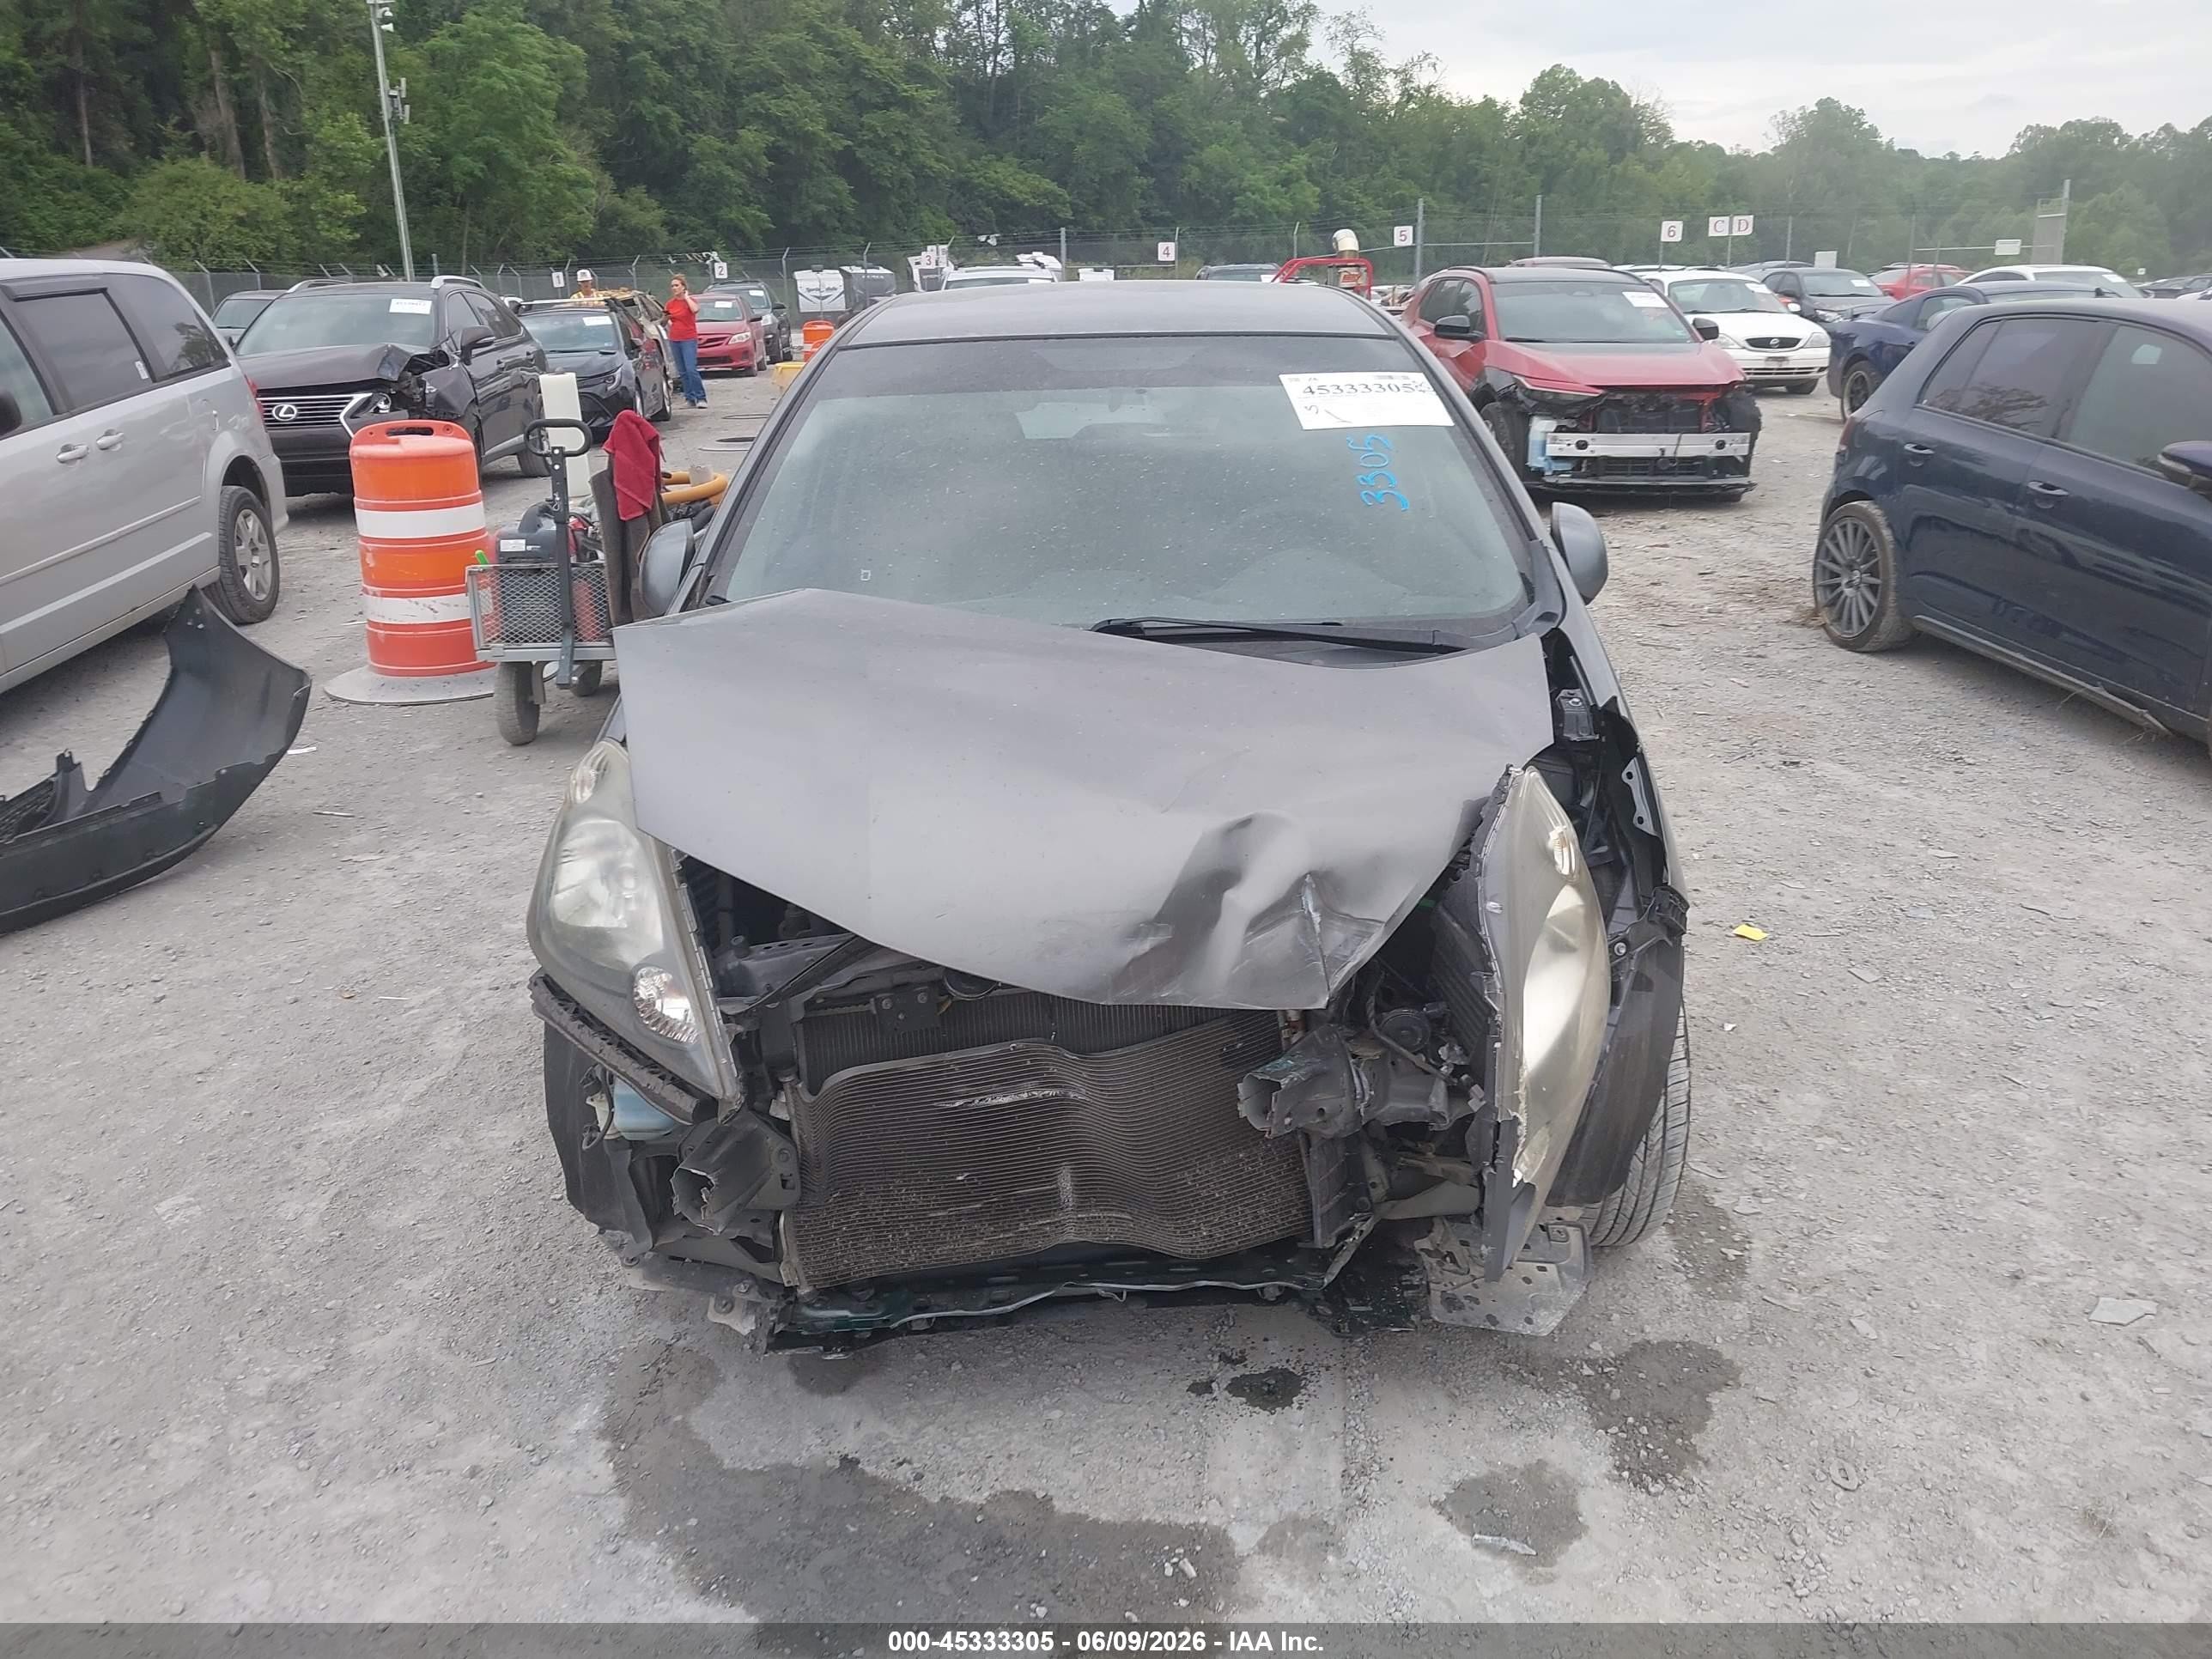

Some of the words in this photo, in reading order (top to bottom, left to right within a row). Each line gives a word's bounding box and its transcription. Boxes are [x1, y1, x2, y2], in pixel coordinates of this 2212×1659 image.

[1668, 225, 1676, 238] 6
[1713, 220, 1725, 234] C
[1737, 219, 1749, 233] D
[1399, 229, 1408, 242] 5
[1162, 246, 1171, 258] 4
[925, 254, 932, 266] 3
[717, 265, 725, 276] 2
[1302, 382, 1416, 396] 45333305
[1346, 433, 1410, 512] 3305
